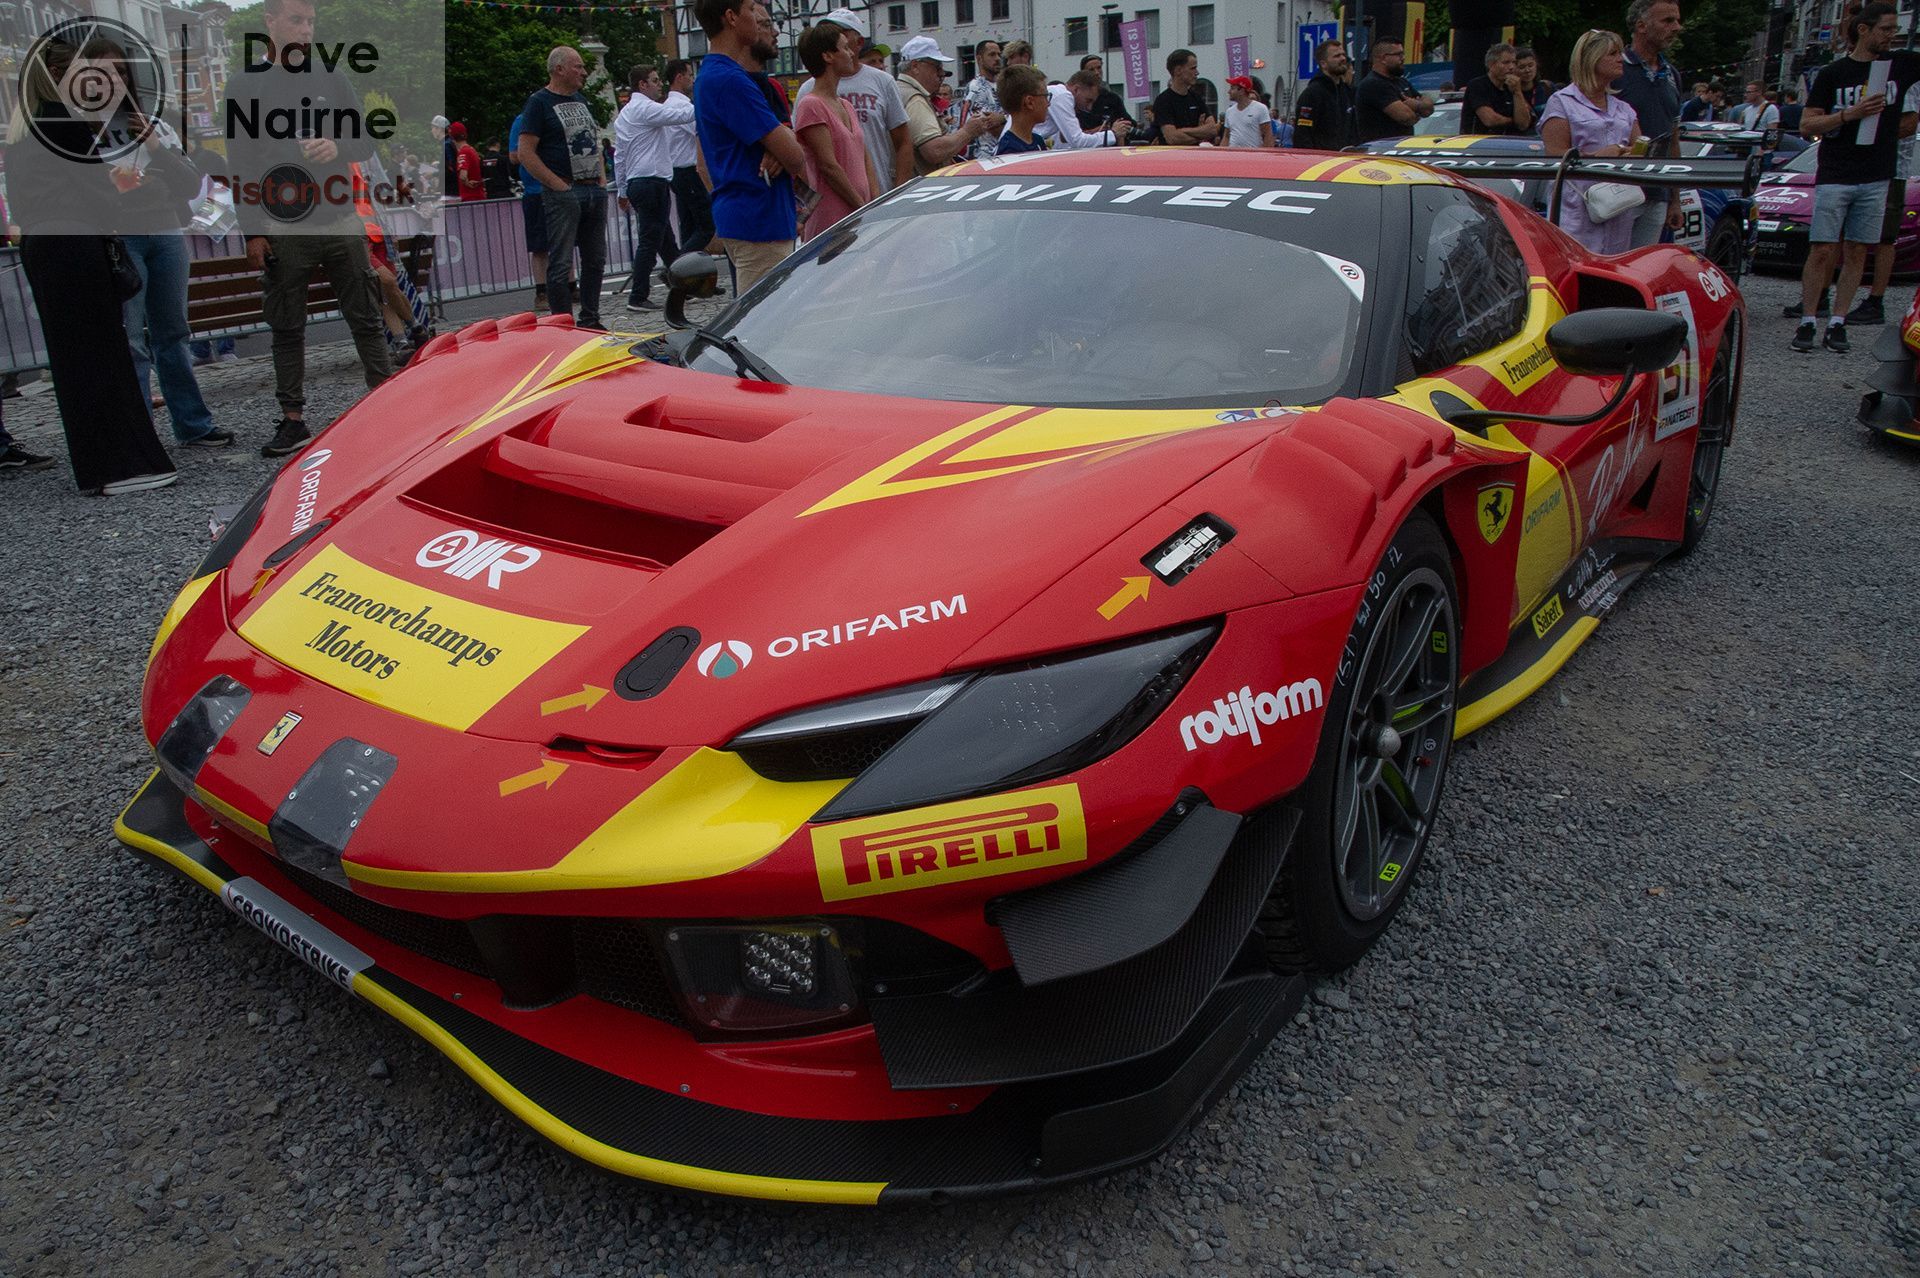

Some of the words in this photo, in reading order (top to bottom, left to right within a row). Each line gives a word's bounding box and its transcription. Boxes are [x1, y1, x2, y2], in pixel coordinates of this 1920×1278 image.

[900, 184, 1333, 214] FANATEC
[290, 470, 322, 536] ORIFARM
[299, 571, 502, 669] Francorchamps
[304, 619, 401, 680] Motors
[767, 594, 968, 658] ORIFARM
[1179, 677, 1324, 751] rotiform
[839, 802, 1061, 886] PIRELLI
[1383, 865, 1399, 880] AF
[232, 894, 351, 989] CROWDSTRIKE
